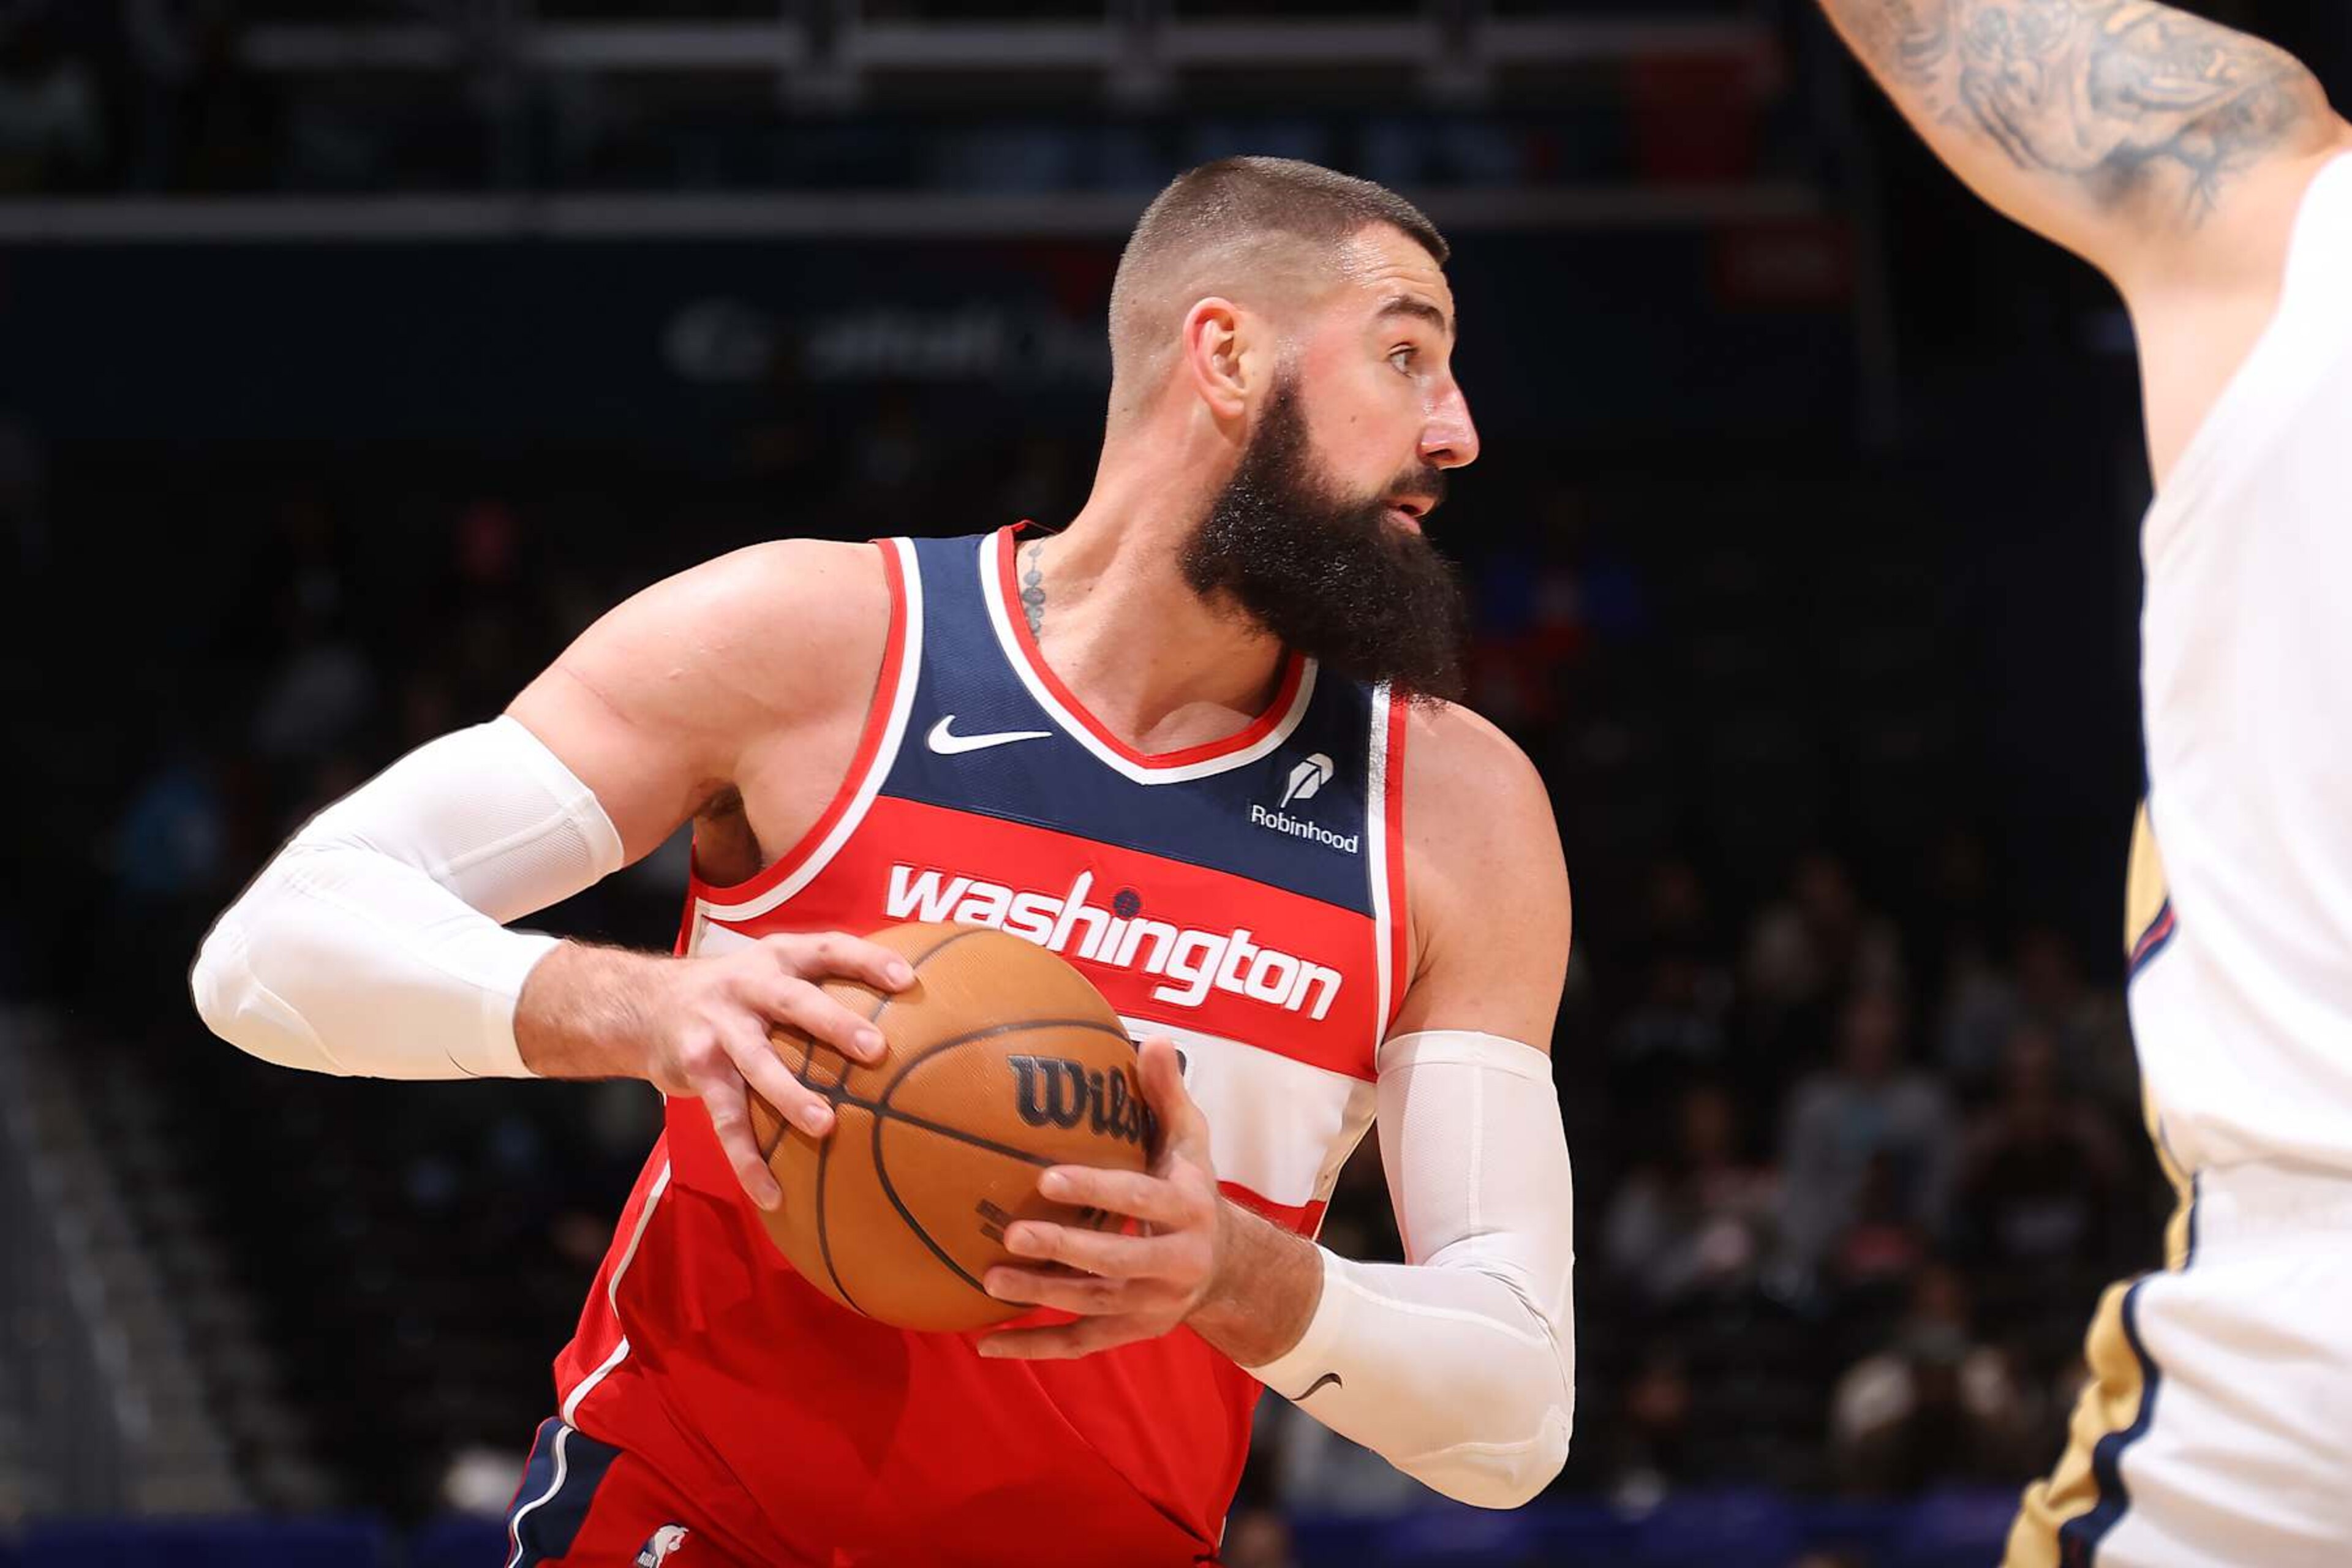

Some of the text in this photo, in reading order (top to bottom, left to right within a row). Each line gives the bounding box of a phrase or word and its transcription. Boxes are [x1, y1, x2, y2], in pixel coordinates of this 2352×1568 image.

[1251, 804, 1359, 854] Robinhood
[885, 863, 1343, 1020] washington
[1006, 1055, 1159, 1153] Wils
